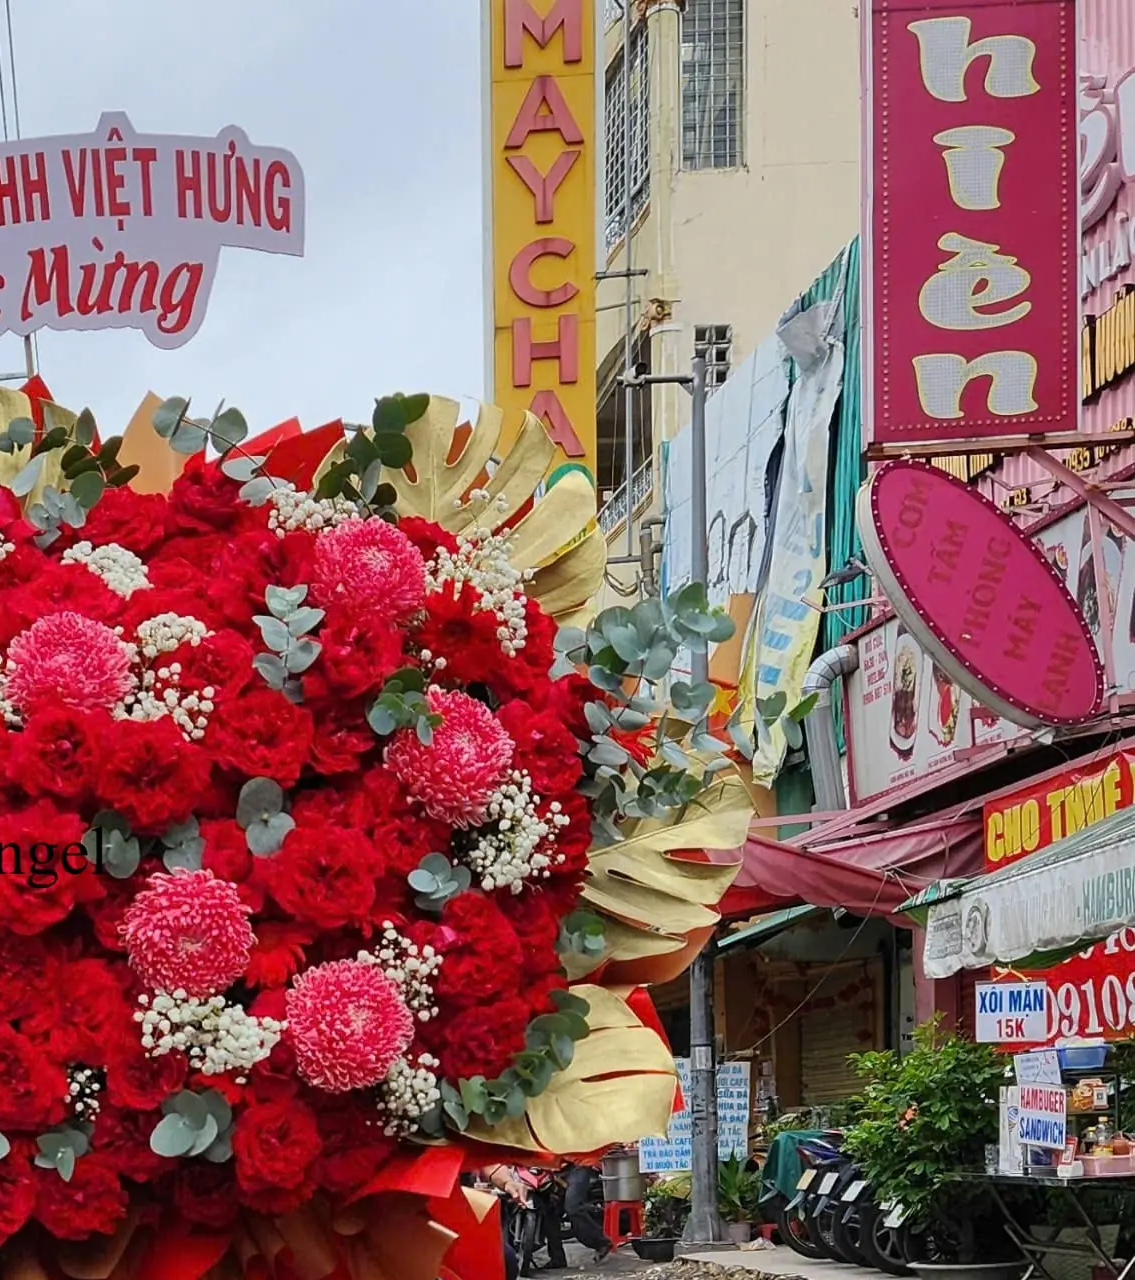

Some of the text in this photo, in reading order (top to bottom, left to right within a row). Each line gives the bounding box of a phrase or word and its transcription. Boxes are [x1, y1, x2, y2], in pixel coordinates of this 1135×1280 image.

[61, 127, 158, 231] VIỆT
[175, 139, 291, 233] HƯNG
[504, 0, 585, 458] MAYCHA
[21, 237, 203, 333] Mừng
[892, 476, 933, 549] CƠM
[958, 536, 1012, 648] PHÒNG
[1003, 593, 1043, 662] MÁY
[987, 799, 1040, 861] CHO
[979, 984, 1044, 1017] XÔI MẶN
[996, 1018, 1026, 1039] 15K
[1019, 1116, 1064, 1145] SANDWICH
[1020, 1087, 1064, 1113] HAMBUGER
